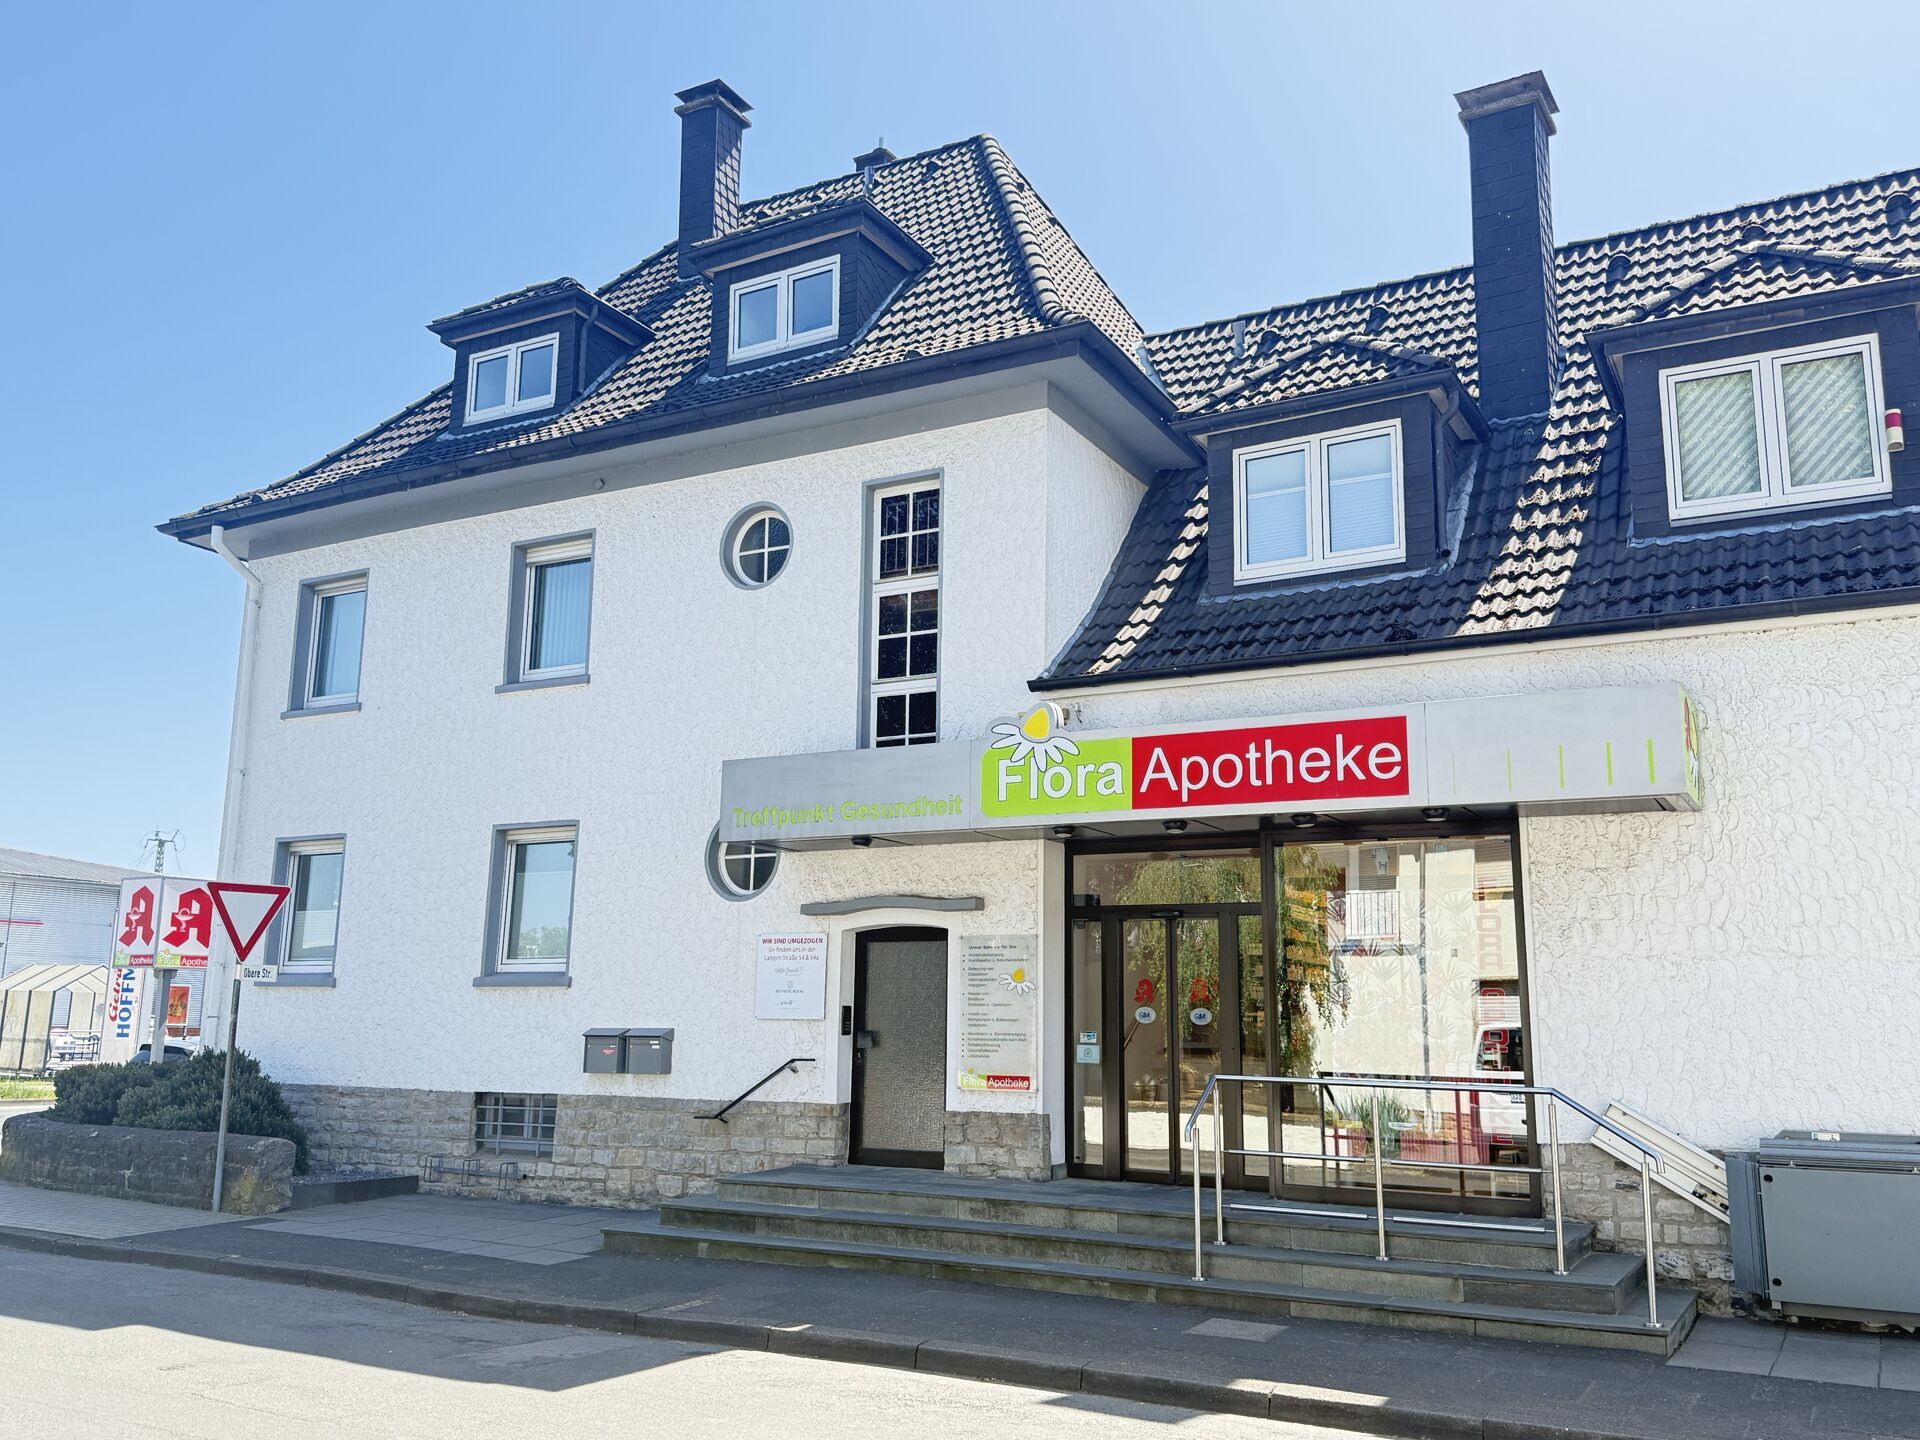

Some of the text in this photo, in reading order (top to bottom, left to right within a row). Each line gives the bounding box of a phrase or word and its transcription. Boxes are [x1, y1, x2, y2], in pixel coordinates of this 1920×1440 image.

[997, 733, 1402, 803] Flora Apotheke
[732, 794, 962, 829] Treffpunkt Gesundheit
[243, 967, 273, 979] Obere Str.
[987, 1077, 1029, 1089] Apotheke
